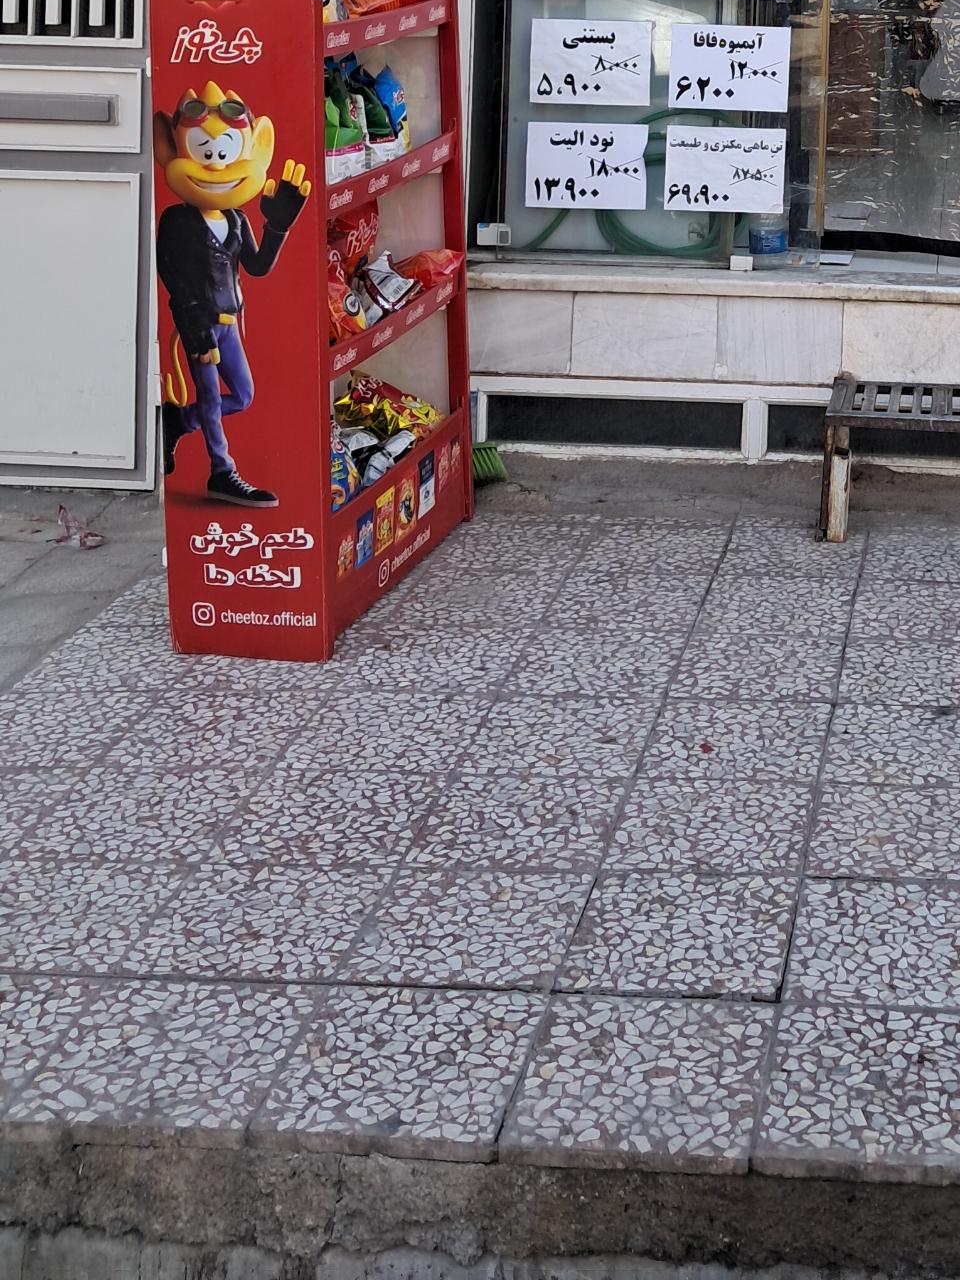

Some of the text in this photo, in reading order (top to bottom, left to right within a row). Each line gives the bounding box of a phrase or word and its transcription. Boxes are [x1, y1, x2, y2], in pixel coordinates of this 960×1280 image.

[562, 27, 616, 50] بستنی
[693, 30, 766, 55] آبمیوه فافا
[589, 130, 615, 153] نود
[669, 136, 770, 154] ماهی مکنزی طبیعت
[189, 522, 314, 559] طعم خوش
[204, 563, 301, 589] لحظه ها
[221, 609, 317, 627] cheetoz.official
